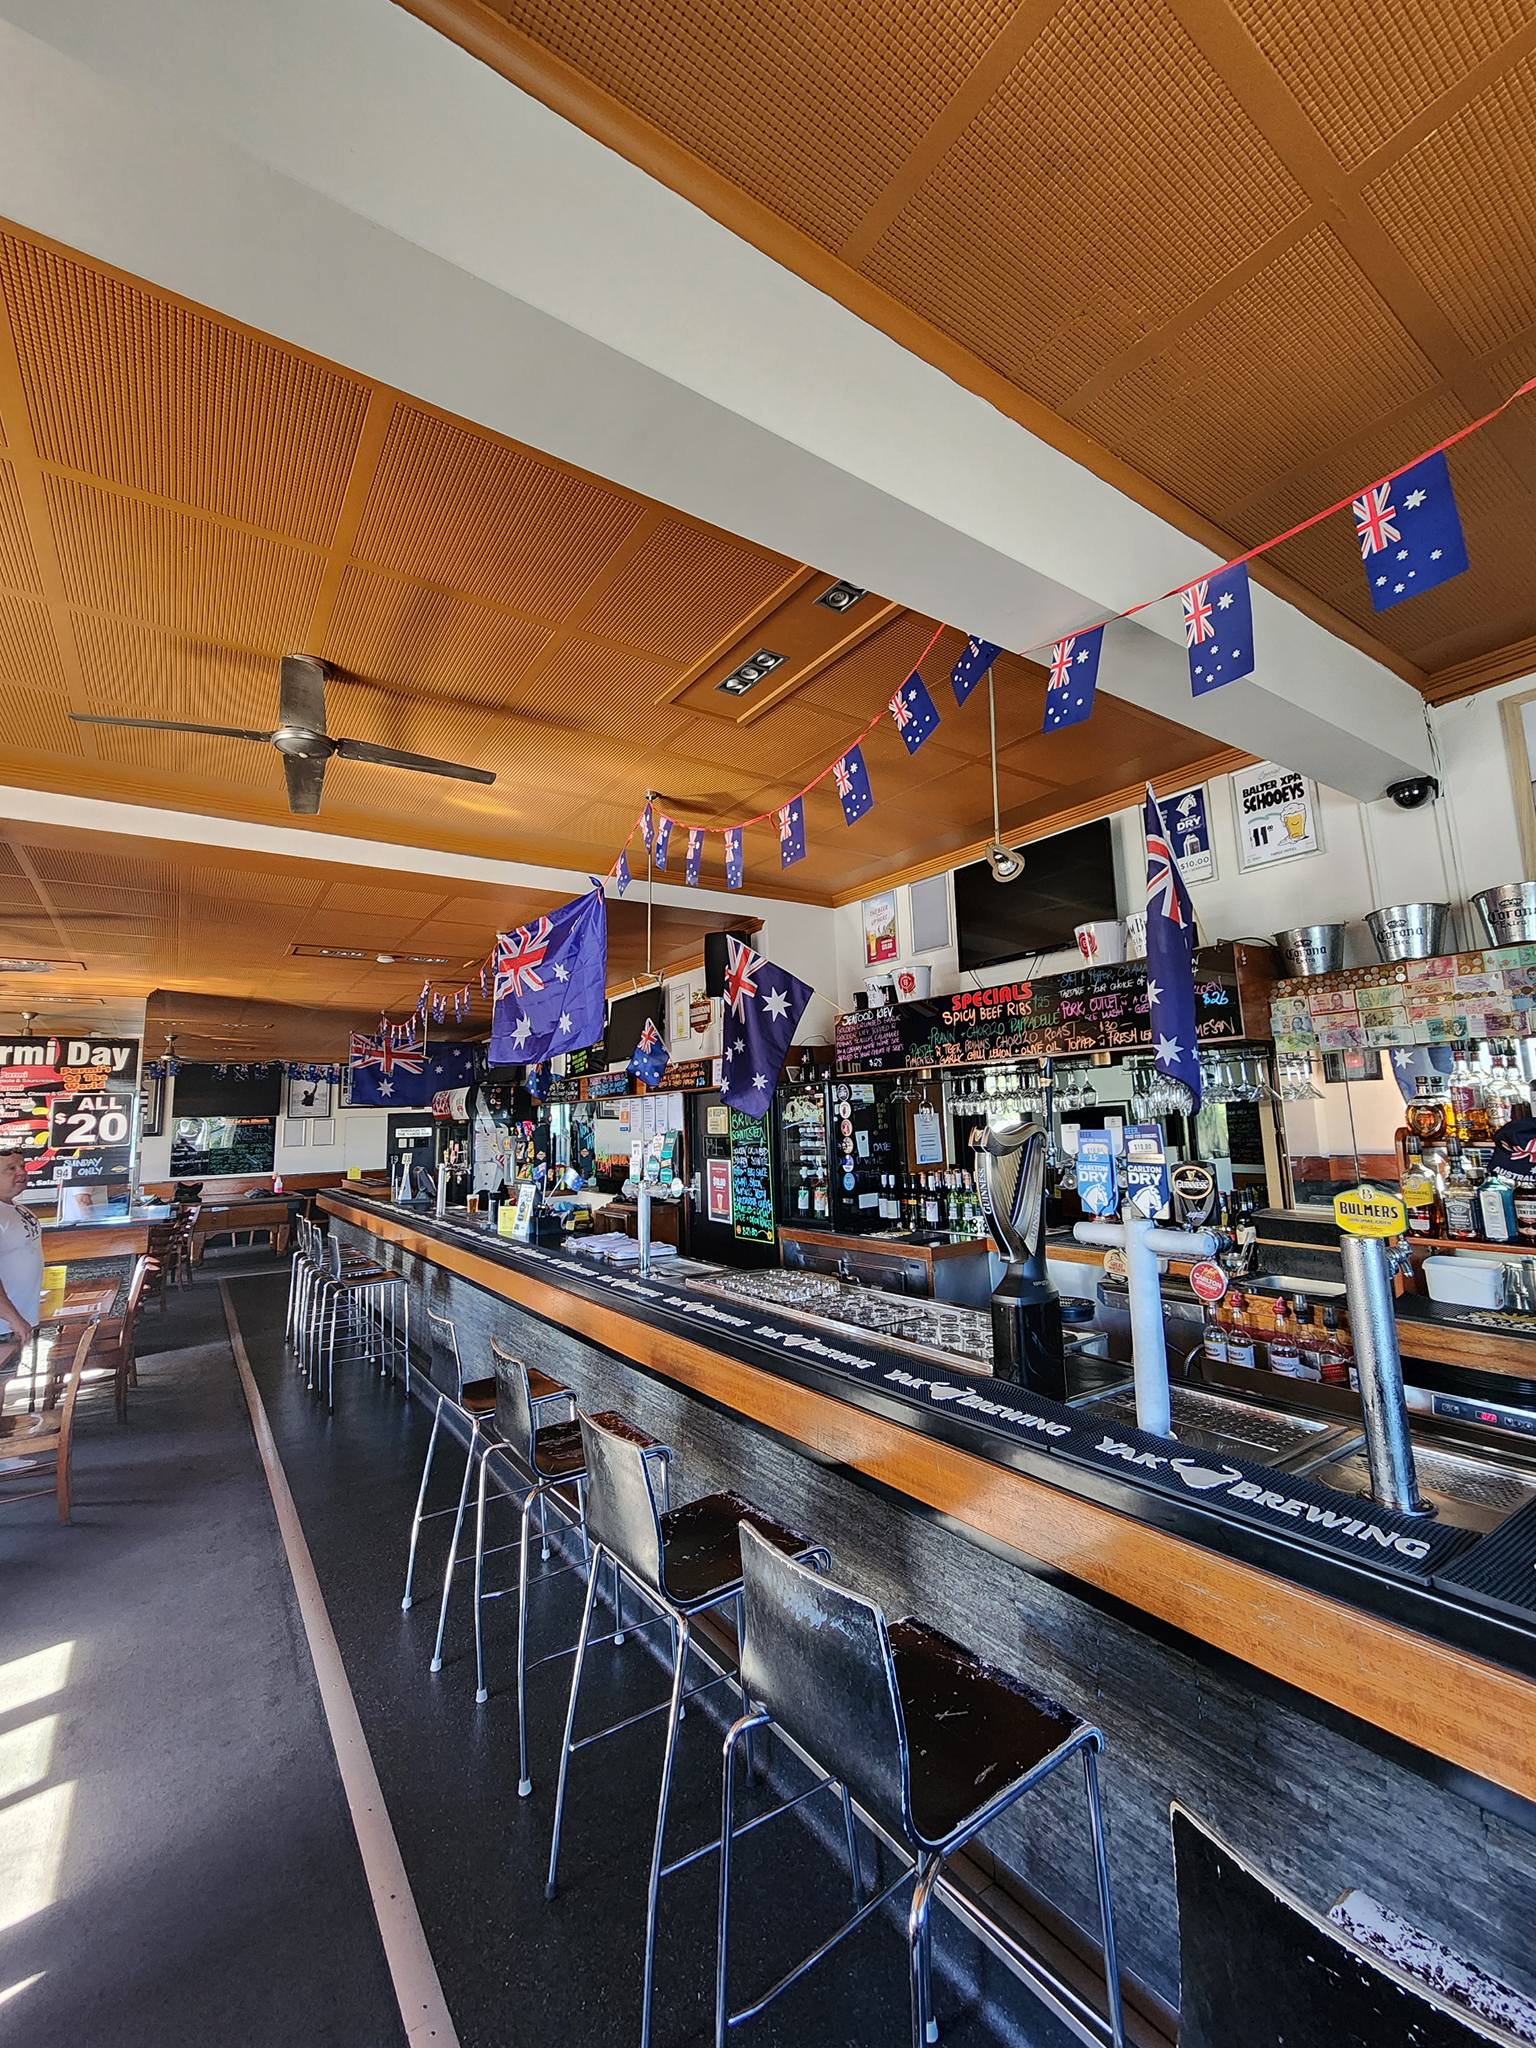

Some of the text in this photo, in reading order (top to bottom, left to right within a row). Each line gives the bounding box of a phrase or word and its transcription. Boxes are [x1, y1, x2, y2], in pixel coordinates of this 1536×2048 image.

[1242, 773, 1302, 798] BALTER XPA
[1243, 782, 1305, 814] SCHOOEYS
[1176, 816, 1201, 831] DRY
[1180, 856, 1209, 870] $10.00
[1488, 906, 1536, 926] Coron
[1376, 926, 1424, 944] Corona
[1285, 945, 1327, 961] Corona
[951, 981, 1033, 1011] SPECIALS
[1202, 990, 1229, 1005] $26
[841, 1006, 893, 1026] SEAFOOD KIEV
[942, 1009, 976, 1026] SPICY
[980, 1005, 1004, 1019] BEEF
[1006, 1000, 1032, 1016] RIBS
[1060, 1000, 1085, 1019] PORK
[1044, 1021, 1081, 1042] ROAST
[1021, 1042, 1044, 1055] OLIVE
[1046, 1041, 1062, 1053] OIL
[1064, 1036, 1096, 1052] TOPPED
[1106, 1028, 1138, 1047] FRESH
[0, 1041, 130, 1071] rmi Day
[63, 1074, 108, 1083] Of The
[64, 1081, 106, 1091] World
[77, 1097, 122, 1110] ALL
[55, 1112, 128, 1144] $20
[1133, 1143, 1152, 1151] $10.00
[63, 1157, 102, 1168] SUNDAY
[1127, 1165, 1162, 1173] CARLTON
[56, 1169, 69, 1178] 94
[77, 1167, 103, 1176] ONLY
[1079, 1172, 1108, 1183] DRY
[1128, 1173, 1162, 1185] DRY
[1493, 1166, 1536, 1182] AUSTRAL
[979, 1167, 992, 1215] GUINNESS
[1175, 1180, 1210, 1190] GUINNESS
[1339, 1202, 1399, 1219] BULMERS
[1194, 1272, 1222, 1289] CARLTON
[800, 1341, 876, 1370] BREWING
[883, 1369, 1072, 1437] YAK BREWING
[1095, 1435, 1431, 1560] YAK BREWING
